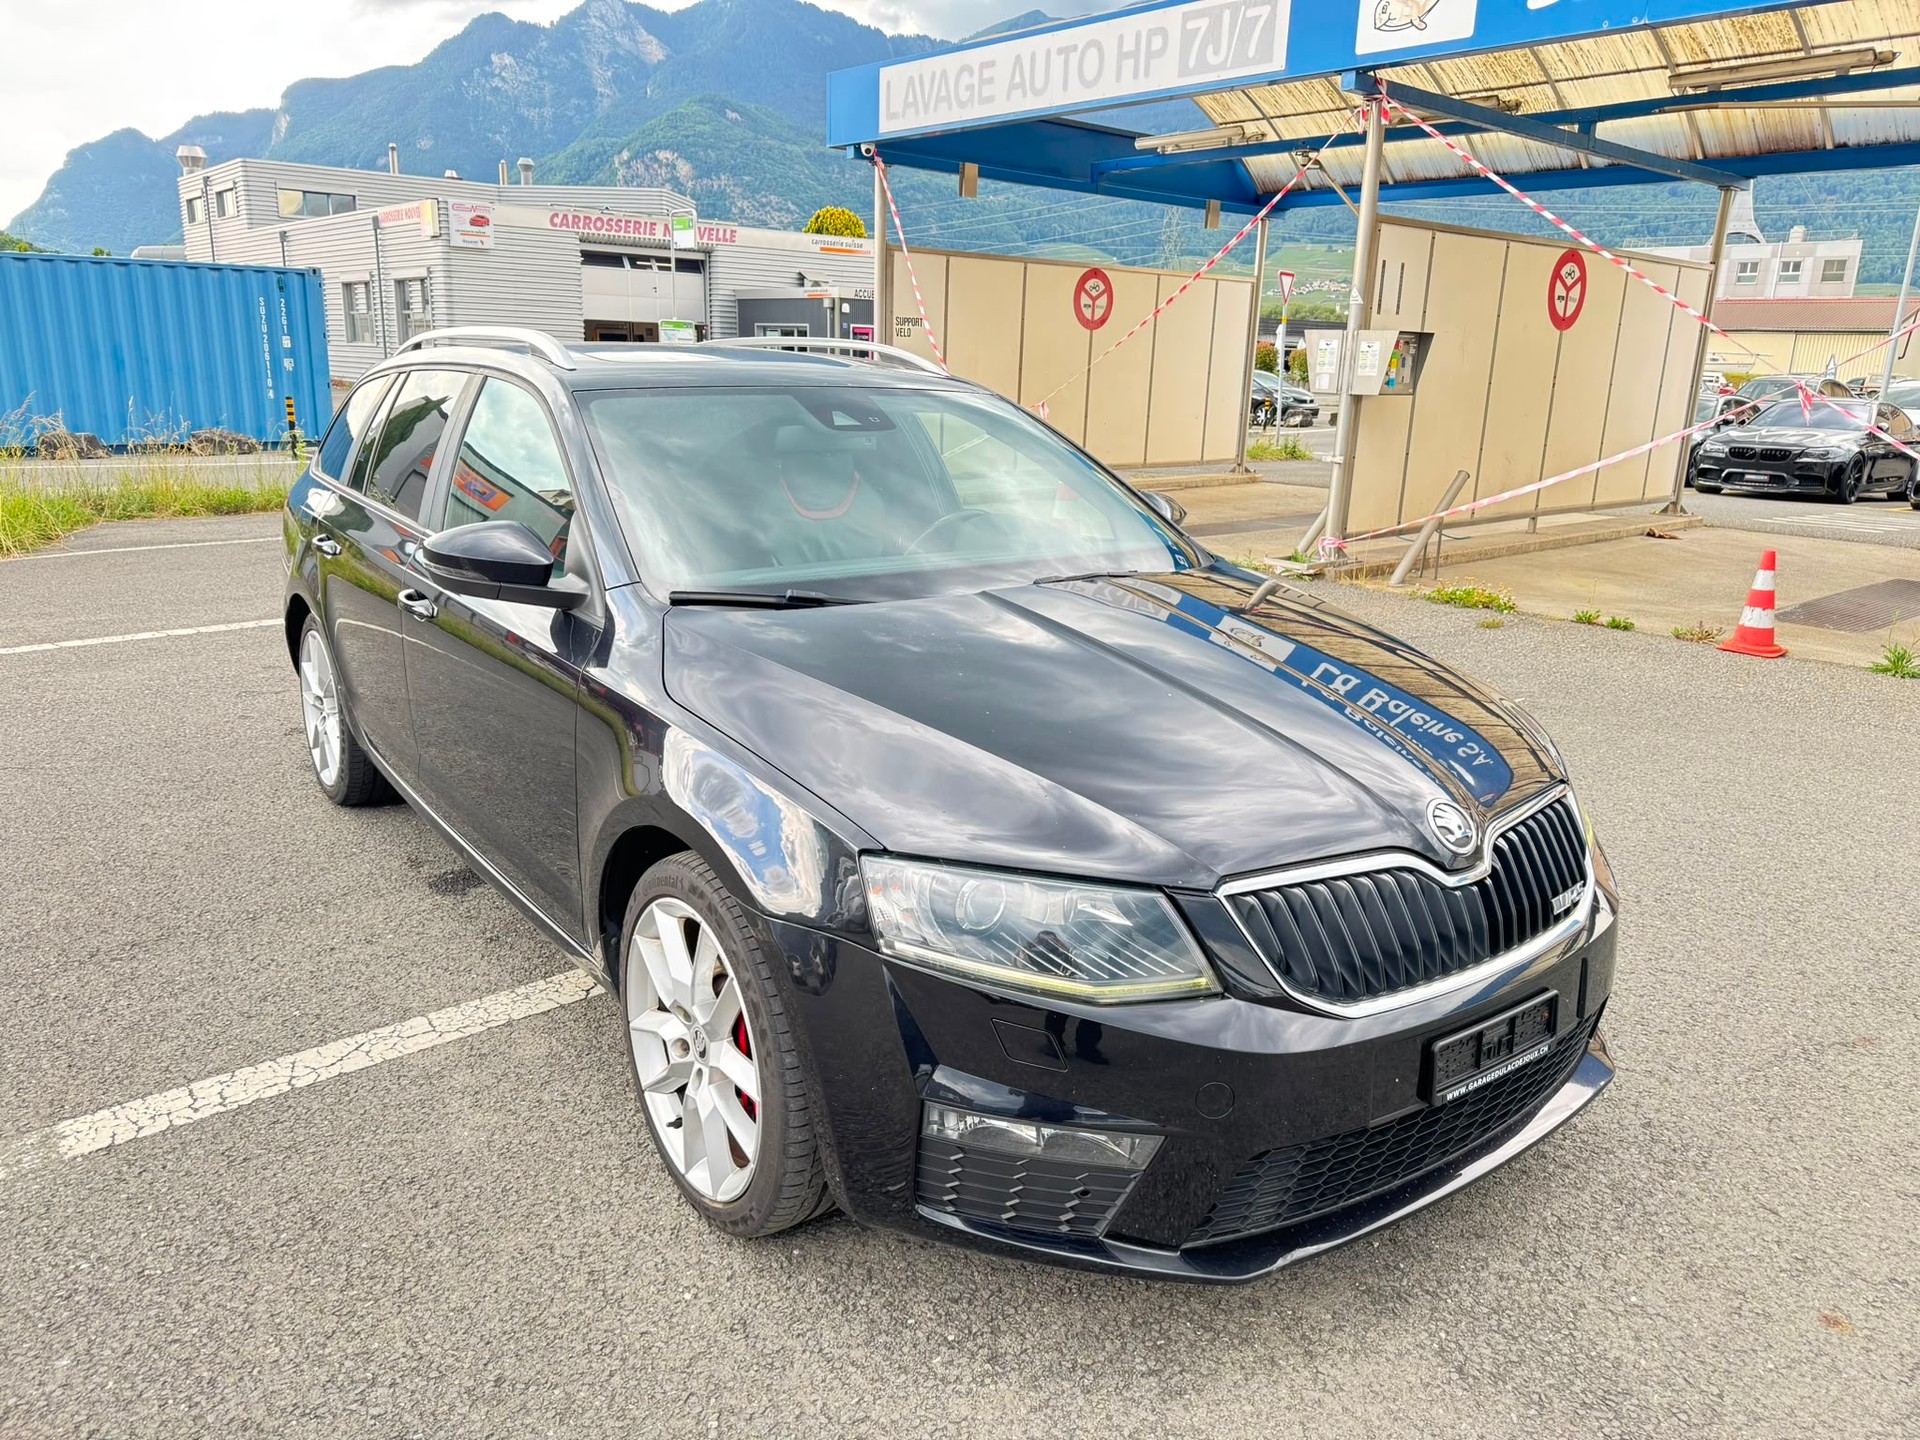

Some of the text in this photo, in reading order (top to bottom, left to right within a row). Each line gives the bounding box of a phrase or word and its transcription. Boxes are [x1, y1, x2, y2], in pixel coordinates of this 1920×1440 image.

[885, 3, 1272, 121] LAVAGE AUTO HP 7J/7
[550, 212, 656, 237] CARROSSERIE
[663, 222, 737, 244] NVELLE
[811, 238, 864, 249] carrosserie suisse
[854, 289, 875, 300] ACCUE
[895, 316, 923, 328] SUPPORT
[895, 327, 912, 338] VELO
[1446, 1045, 1549, 1101] WWW.GARAGEDULACDEJOUX.CH
